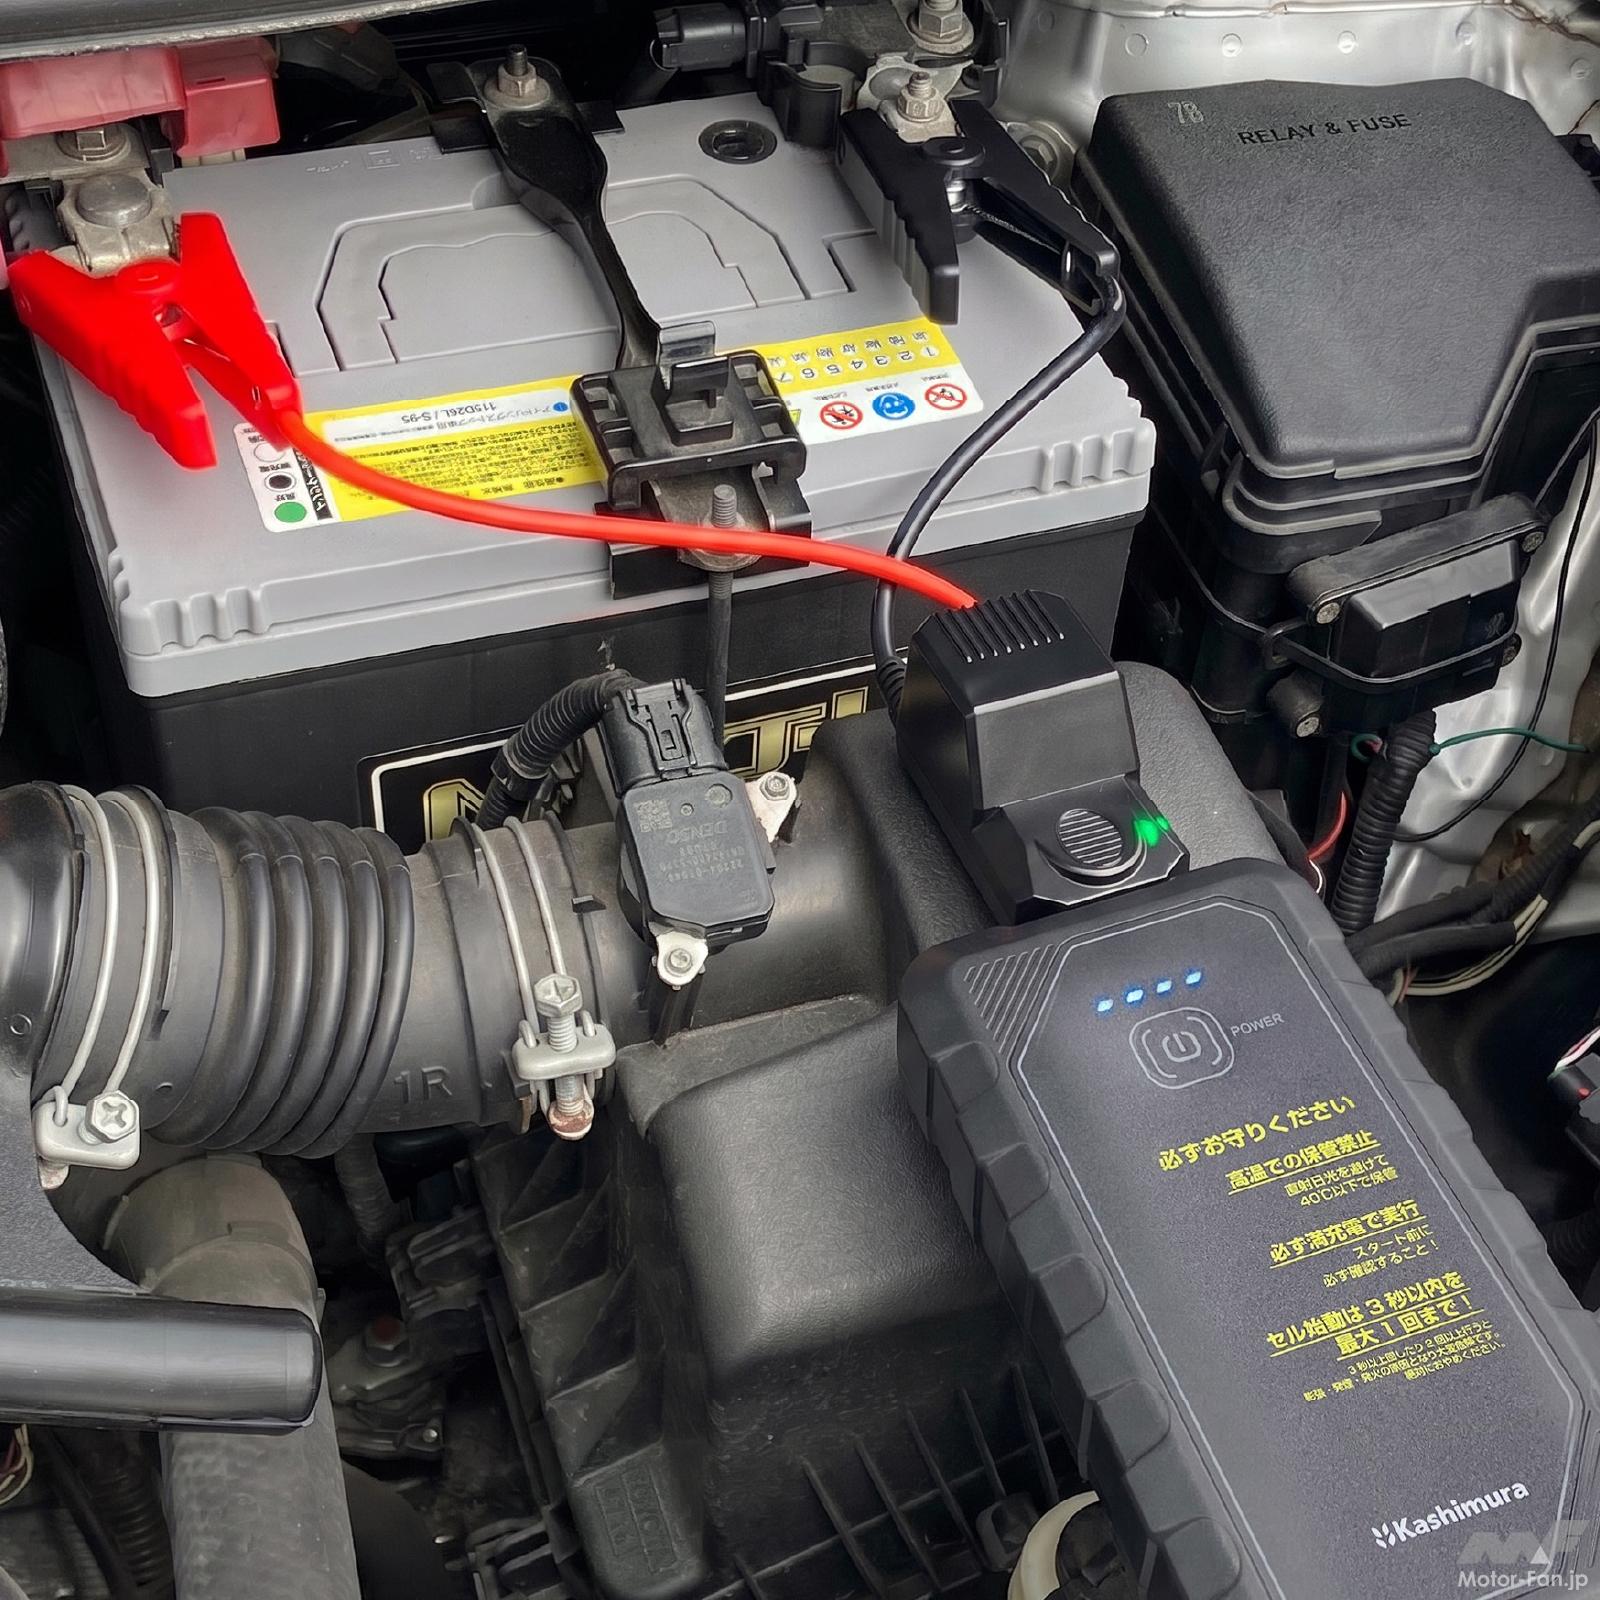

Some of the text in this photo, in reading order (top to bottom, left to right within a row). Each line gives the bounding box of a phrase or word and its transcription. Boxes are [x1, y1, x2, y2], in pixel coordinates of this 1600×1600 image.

[1237, 113, 1412, 145] RELAY & FUSE
[888, 335, 905, 345] Feb
[816, 347, 834, 358] May
[875, 356, 888, 366] 3
[901, 351, 913, 361] 2
[926, 347, 937, 357] 1
[802, 368, 815, 379] 6
[826, 364, 841, 374] 5
[851, 360, 865, 370] 4
[401, 410, 430, 424] S-95
[441, 400, 497, 418] 115D26L
[1230, 1012, 1285, 1037] POWER
[394, 1066, 452, 1104] 1R
[1159, 1096, 1356, 1171] 必ずお守りください
[1225, 1129, 1378, 1190] 高温での保管禁止
[1284, 1154, 1389, 1197] 直射日光を避けて
[1270, 1199, 1421, 1263] 必ず満充電で実行
[1353, 1224, 1434, 1259] スタート前に
[1391, 1481, 1530, 1543] Kashimura
